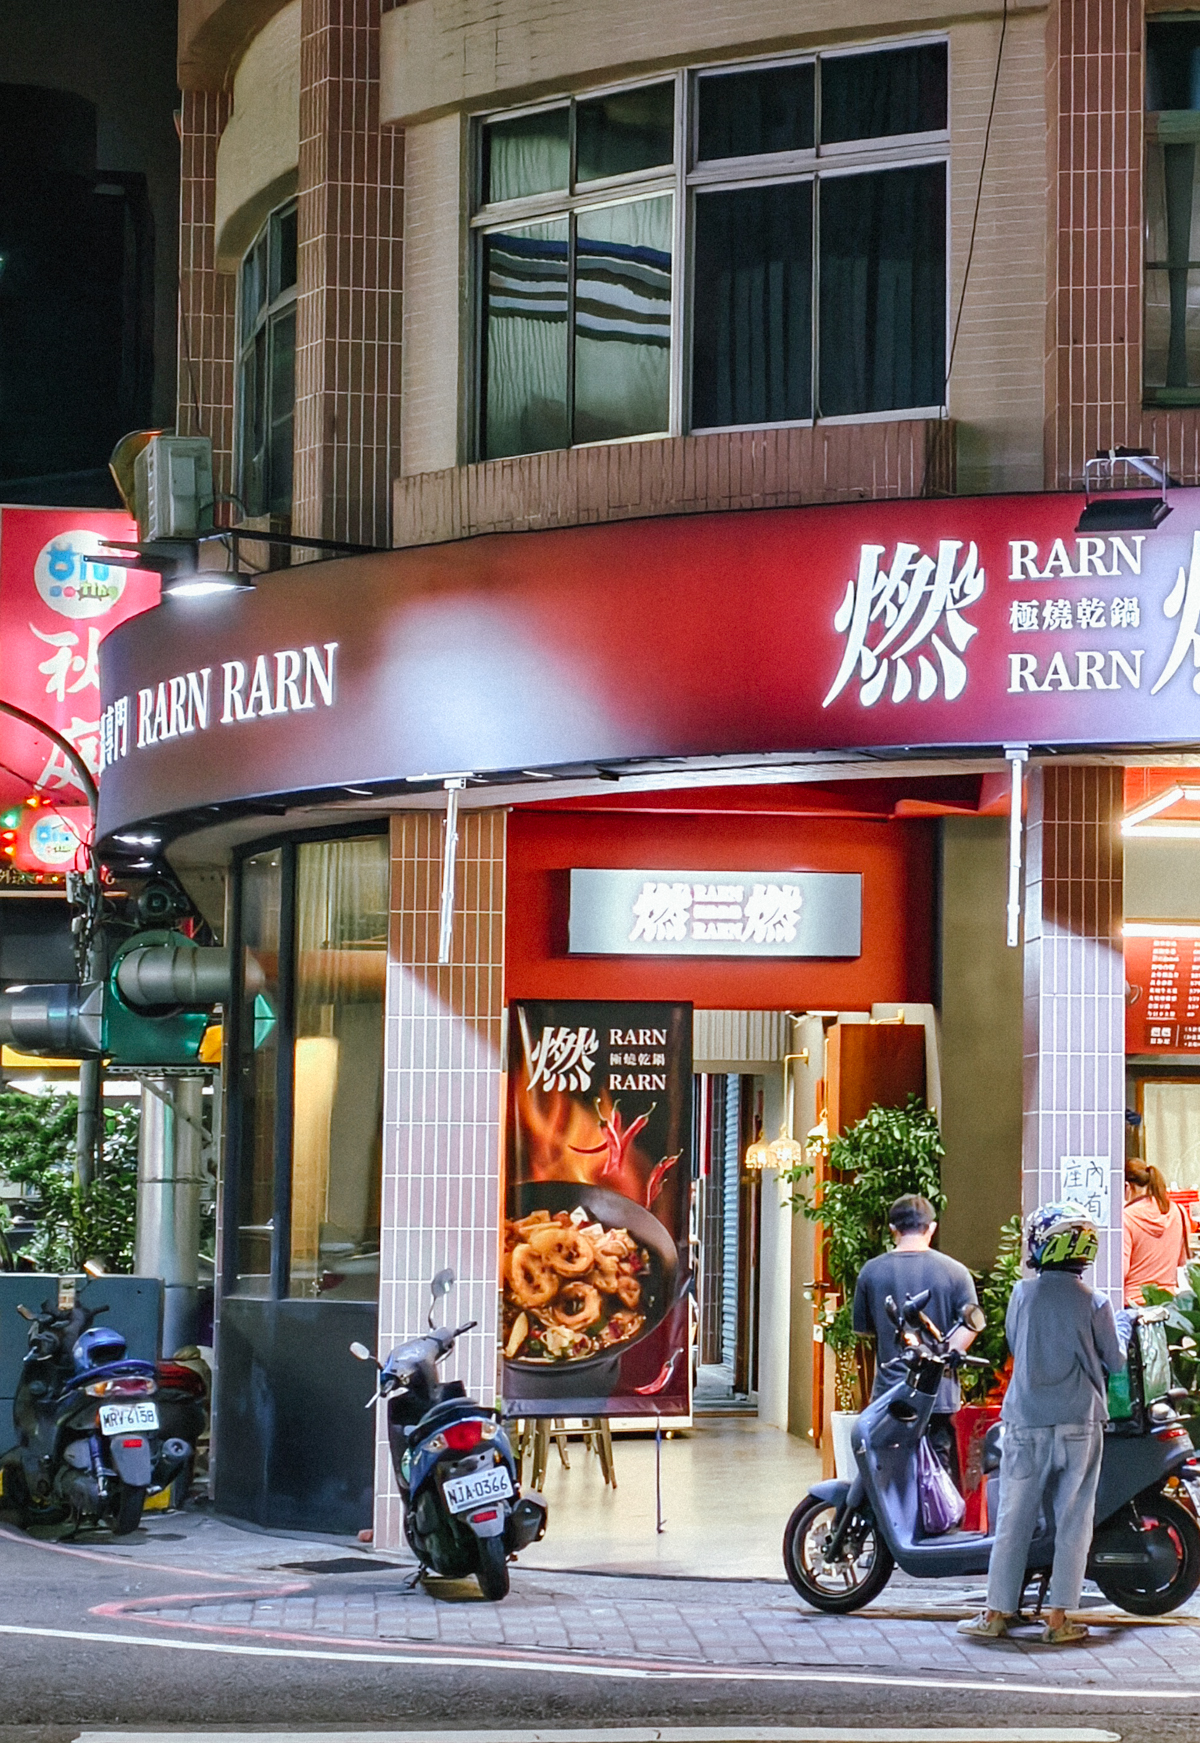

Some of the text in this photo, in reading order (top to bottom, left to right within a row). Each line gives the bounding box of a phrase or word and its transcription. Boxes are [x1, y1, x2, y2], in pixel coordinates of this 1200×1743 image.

[1008, 536, 1147, 580] RARN
[822, 540, 985, 708] 燃
[1008, 597, 1141, 634] 極燒乾鍋
[1007, 649, 1146, 693] RARN
[137, 668, 211, 748] RARN
[220, 642, 339, 724] RARN
[526, 1026, 600, 1092] 燃
[609, 1028, 667, 1046] RARN
[608, 1073, 667, 1091] RARN
